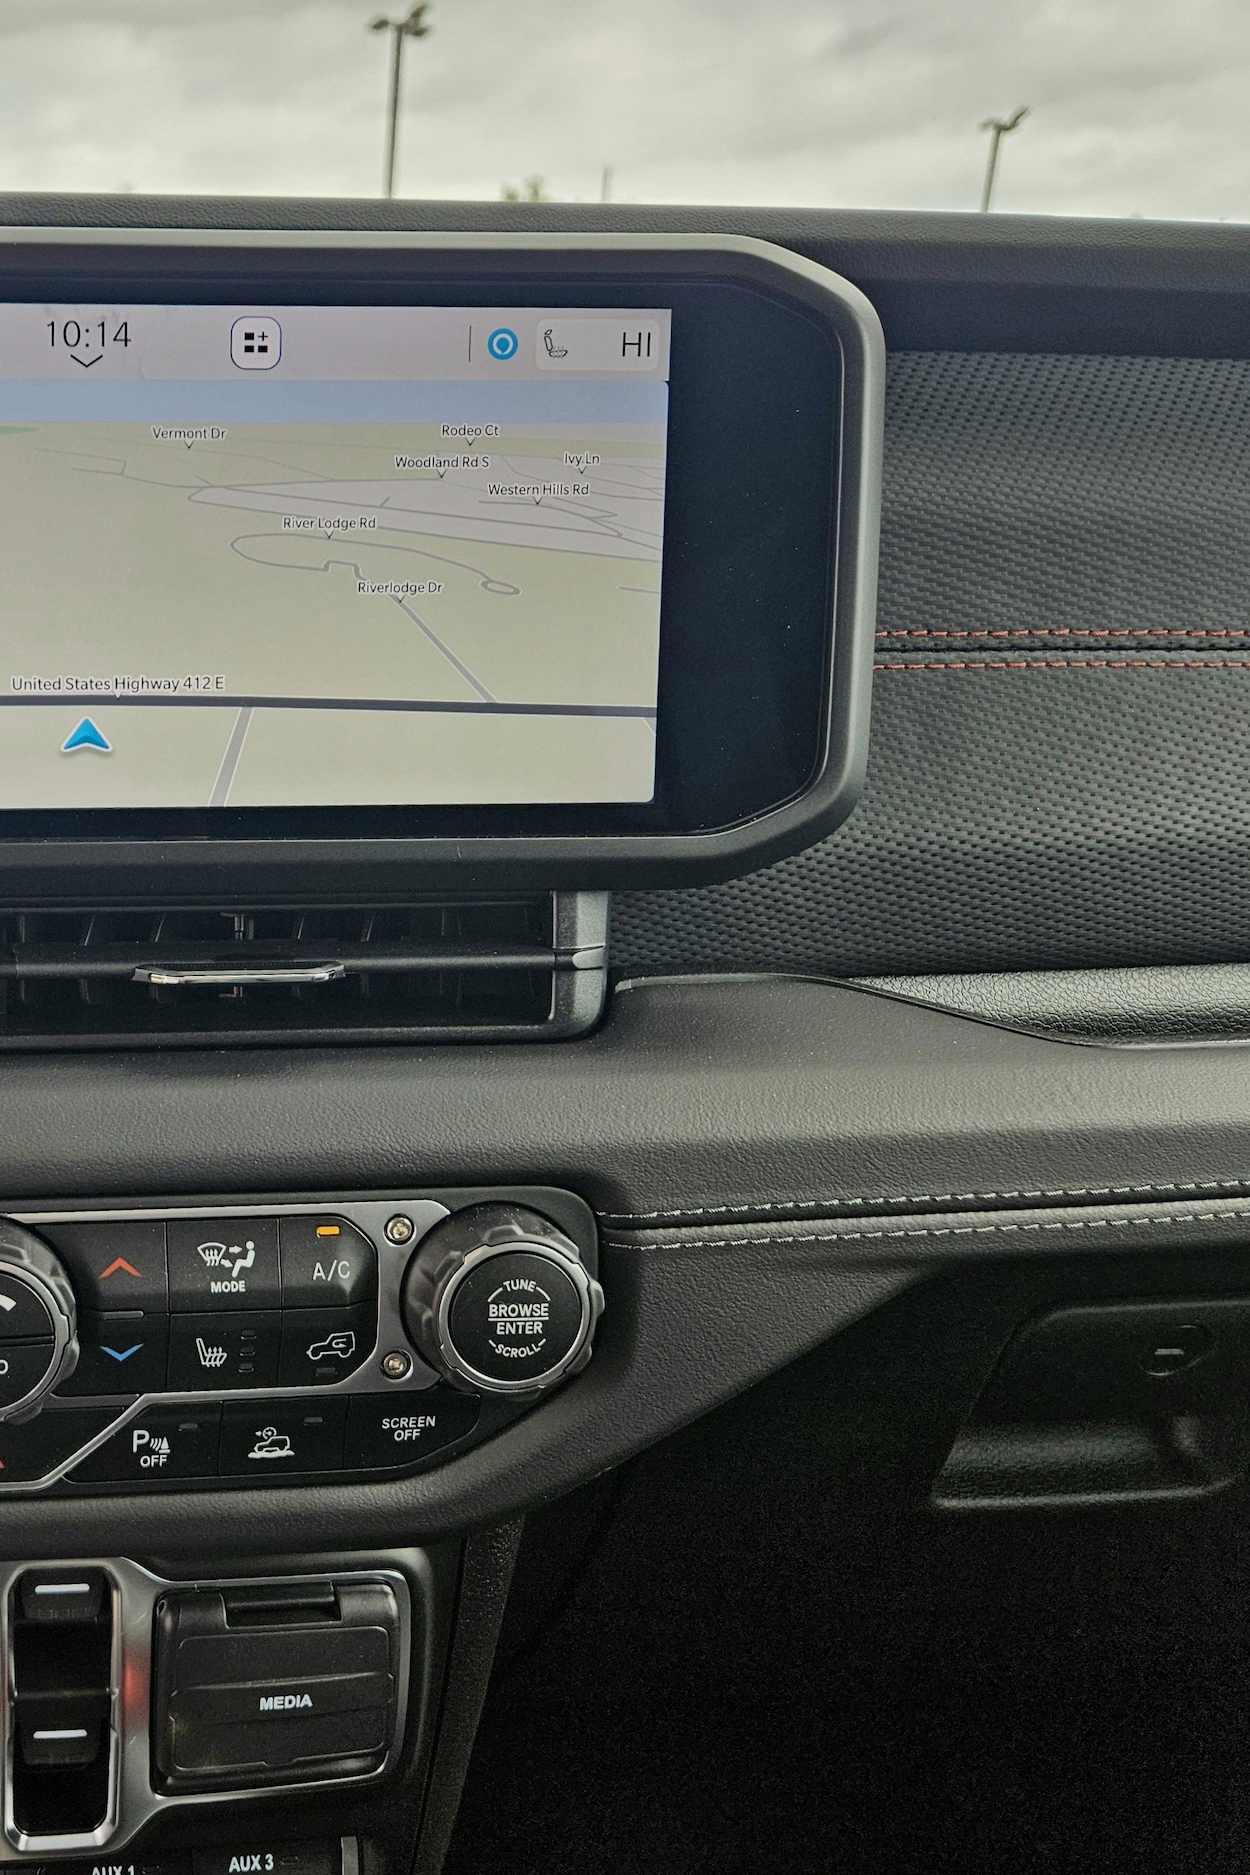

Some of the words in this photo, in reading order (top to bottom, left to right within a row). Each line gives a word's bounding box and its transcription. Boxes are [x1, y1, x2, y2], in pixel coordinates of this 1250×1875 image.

[45, 320, 133, 349] 10:14
[621, 331, 653, 358] HI
[152, 427, 207, 440] Vermont
[211, 427, 226, 440] Dr
[441, 424, 482, 437] Rodeo
[485, 424, 499, 437] Ct
[395, 456, 459, 469] Woodland
[462, 456, 479, 468] Rd
[481, 456, 490, 468] S
[564, 453, 583, 466] Ivy
[585, 453, 600, 465] Ln
[488, 483, 539, 496] Western
[542, 483, 570, 496] Hills
[572, 483, 589, 496] Rd
[283, 516, 315, 529] River
[317, 516, 356, 531] Lodge
[359, 516, 376, 529] Rd
[358, 581, 425, 596] Riverlodge
[428, 582, 443, 594] Dr
[11, 676, 61, 691] United
[65, 676, 111, 691] States
[114, 676, 180, 693] Highway
[182, 676, 212, 690] 412
[215, 676, 225, 690] E
[312, 1259, 351, 1281] A/C
[210, 1280, 246, 1294] MODE
[502, 1278, 538, 1294] TUNE
[488, 1302, 550, 1319] BROWSE
[495, 1320, 544, 1336] ENTER
[494, 1341, 542, 1359] SCROLL
[381, 1415, 437, 1430] SCREEN
[393, 1428, 422, 1442] OFF
[139, 1454, 168, 1468] OFF
[259, 1692, 314, 1712] MEDIA
[229, 1854, 262, 1873] AUX
[264, 1853, 275, 1871] 3
